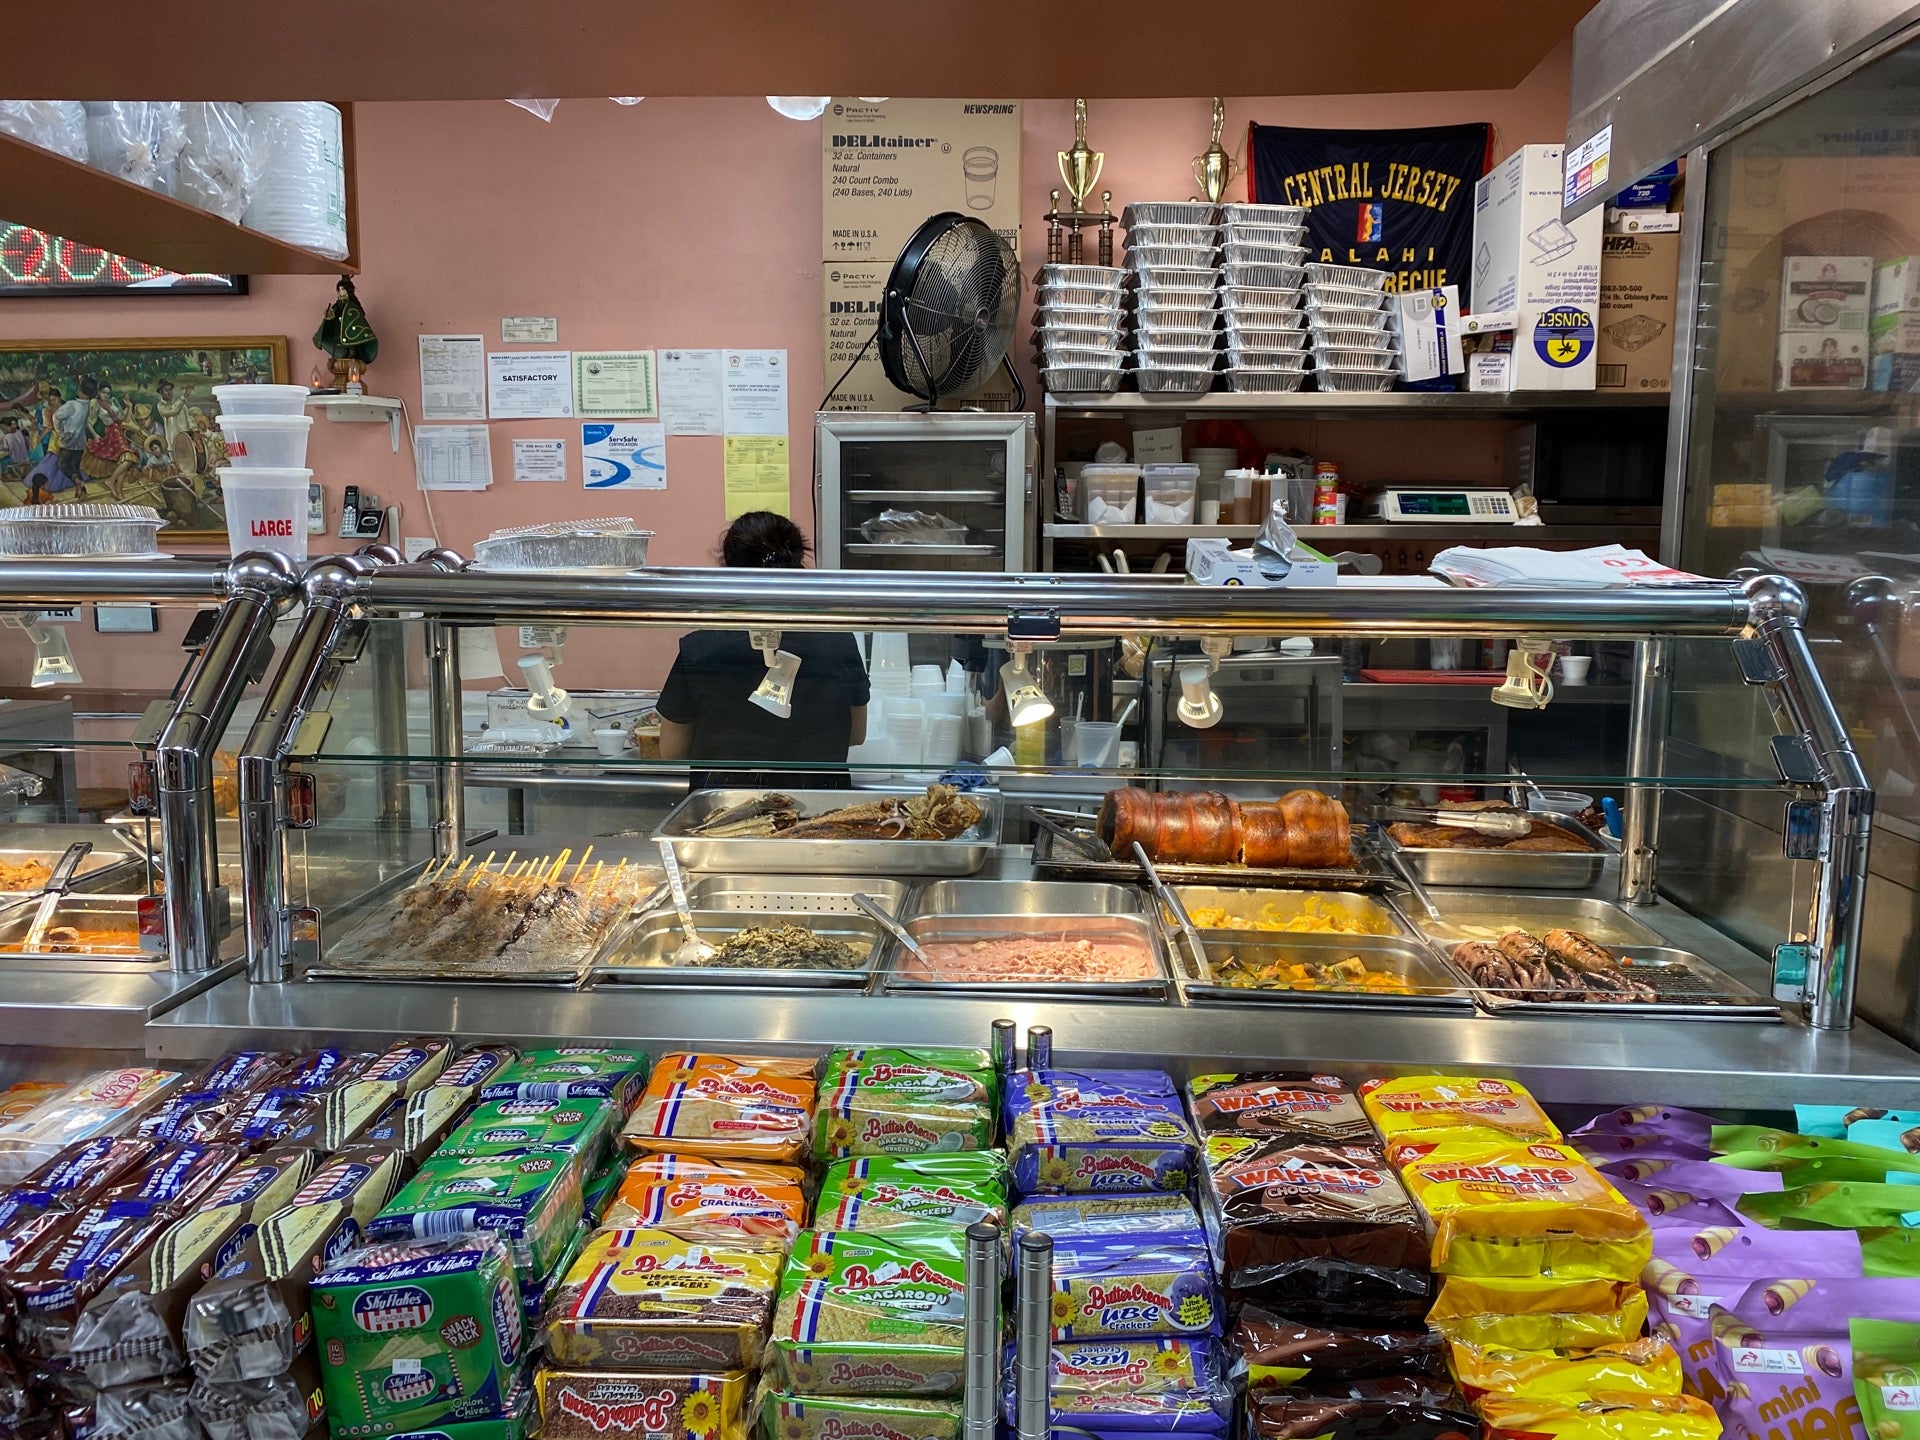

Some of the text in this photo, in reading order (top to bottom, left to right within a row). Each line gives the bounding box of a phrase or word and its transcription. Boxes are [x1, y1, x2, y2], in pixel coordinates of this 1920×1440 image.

[963, 104, 1014, 114] NEWSPRING
[832, 135, 935, 148] DELItainer
[832, 152, 843, 160] 32
[857, 152, 897, 160] Containers
[832, 164, 860, 172] Natural
[832, 176, 899, 185] 240 Count Combo
[1284, 162, 1373, 207] CENTRAL
[1381, 162, 1461, 212] JERSEY
[832, 188, 912, 198] (240 Bases, 240 Lids)
[832, 230, 879, 238] MADE IN U.S.A.
[1603, 236, 1635, 250] HFA
[1321, 247, 1435, 262] ALAHI
[830, 318, 840, 326] 32
[1539, 312, 1591, 327] SUNSET
[830, 330, 857, 338] Natural
[830, 342, 845, 350] 240
[830, 353, 846, 362] (240
[502, 374, 558, 382] SATISFACTORY
[251, 519, 293, 537] LARGE
[218, 1056, 250, 1089] Magic
[480, 1088, 515, 1100] SkyFlakes
[1211, 1091, 1346, 1113] WAFRETS
[1241, 1107, 1288, 1119] CHOCO
[878, 1139, 928, 1150] MACAROON
[1530, 1146, 1560, 1156] EXTRA
[61, 1146, 104, 1187] Magic
[520, 1160, 552, 1168] SNACK
[524, 1165, 550, 1173] PACK
[153, 1149, 197, 1199] Magic
[1090, 1174, 1143, 1187] UBE
[1234, 1167, 1384, 1188] WAFRETS
[138, 1167, 166, 1198] CREAMS
[1462, 1183, 1515, 1194] CHEESE
[1267, 1185, 1320, 1198] CHOCO
[73, 1208, 104, 1242] FREE
[49, 1247, 75, 1271] PACK
[367, 1265, 418, 1281] SkyFlakes
[423, 1258, 475, 1273] SkyFlakes
[647, 1281, 710, 1289] CRACKERS
[27, 1288, 75, 1307] Magic
[363, 1292, 422, 1310] SkyFlakes
[859, 1289, 949, 1305] MACAROON
[1184, 1304, 1206, 1313] talaga!
[375, 1313, 415, 1322] CRACKERS
[1101, 1307, 1159, 1326] UBE
[441, 1316, 476, 1338] SNACK
[494, 1297, 511, 1357] SkyFlakes
[1109, 1322, 1152, 1330] Crackers
[451, 1328, 480, 1347] PACK
[331, 1344, 340, 1352] 10
[1071, 1352, 1129, 1366] UBE
[390, 1373, 427, 1388] SkyFlakes
[851, 1379, 911, 1388] MACAROON
[311, 1387, 323, 1411] 10
[588, 1391, 643, 1400] CHOCOLATE
[1758, 1375, 1822, 1423] mini
[453, 1398, 484, 1408] Onion
[455, 1406, 491, 1418] Chives
